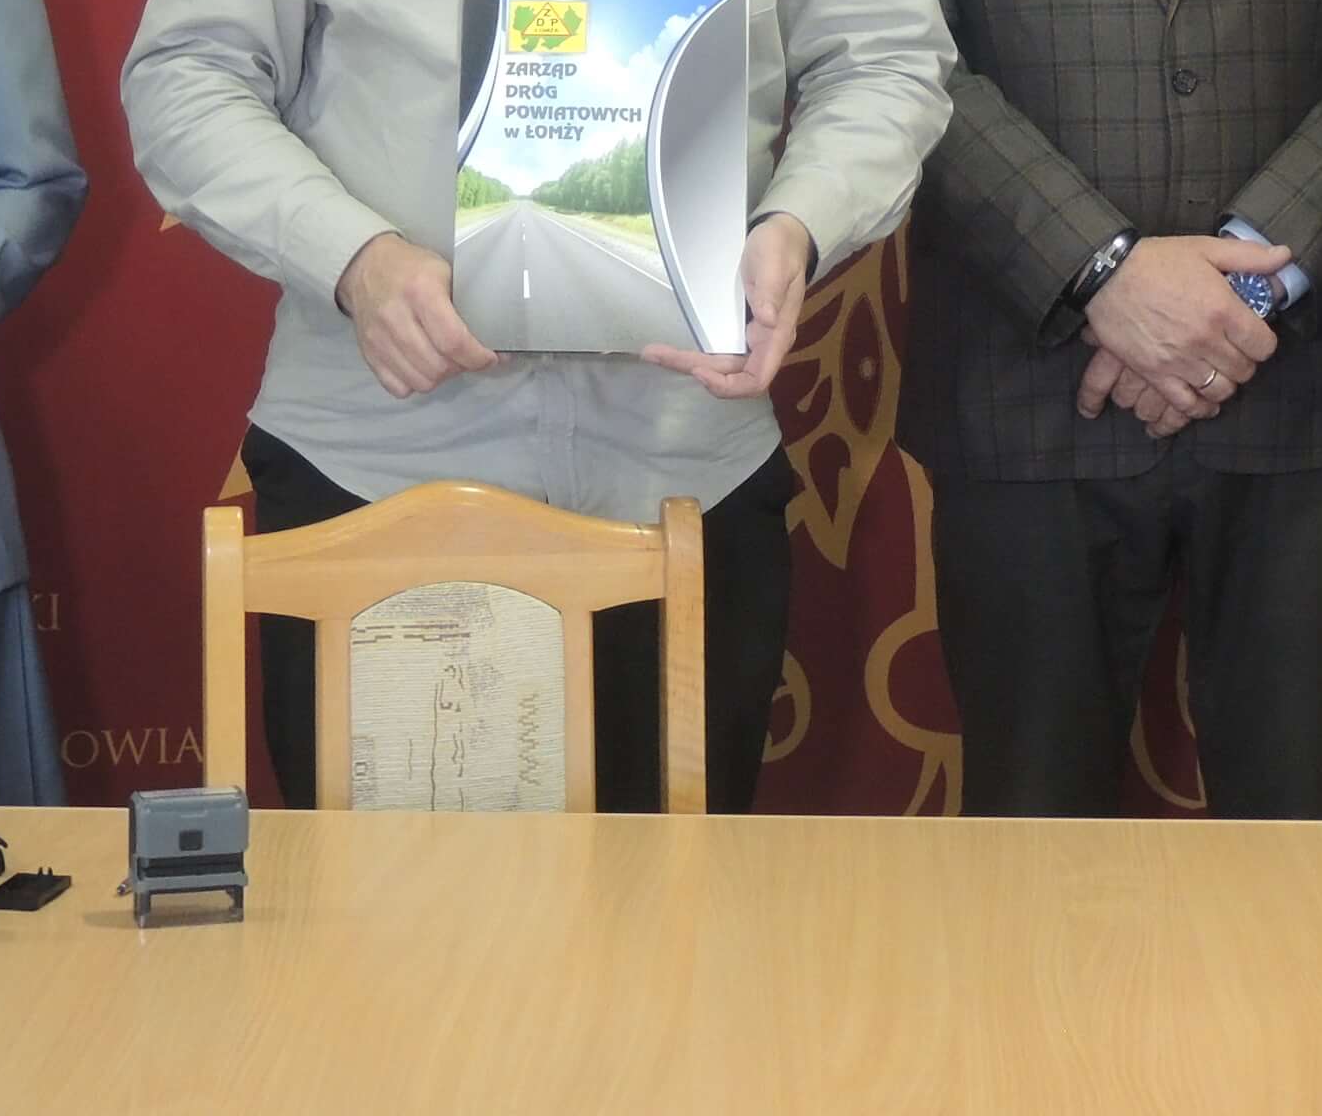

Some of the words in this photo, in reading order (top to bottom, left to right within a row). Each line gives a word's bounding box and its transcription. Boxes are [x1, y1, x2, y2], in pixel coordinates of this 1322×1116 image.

[505, 61, 577, 80] ZARZĄD
[505, 82, 558, 100] DRÓG
[504, 105, 643, 123] POWIATOWYCH
[525, 122, 585, 141] ŁOMŻY
[61, 727, 204, 769] OWIA
